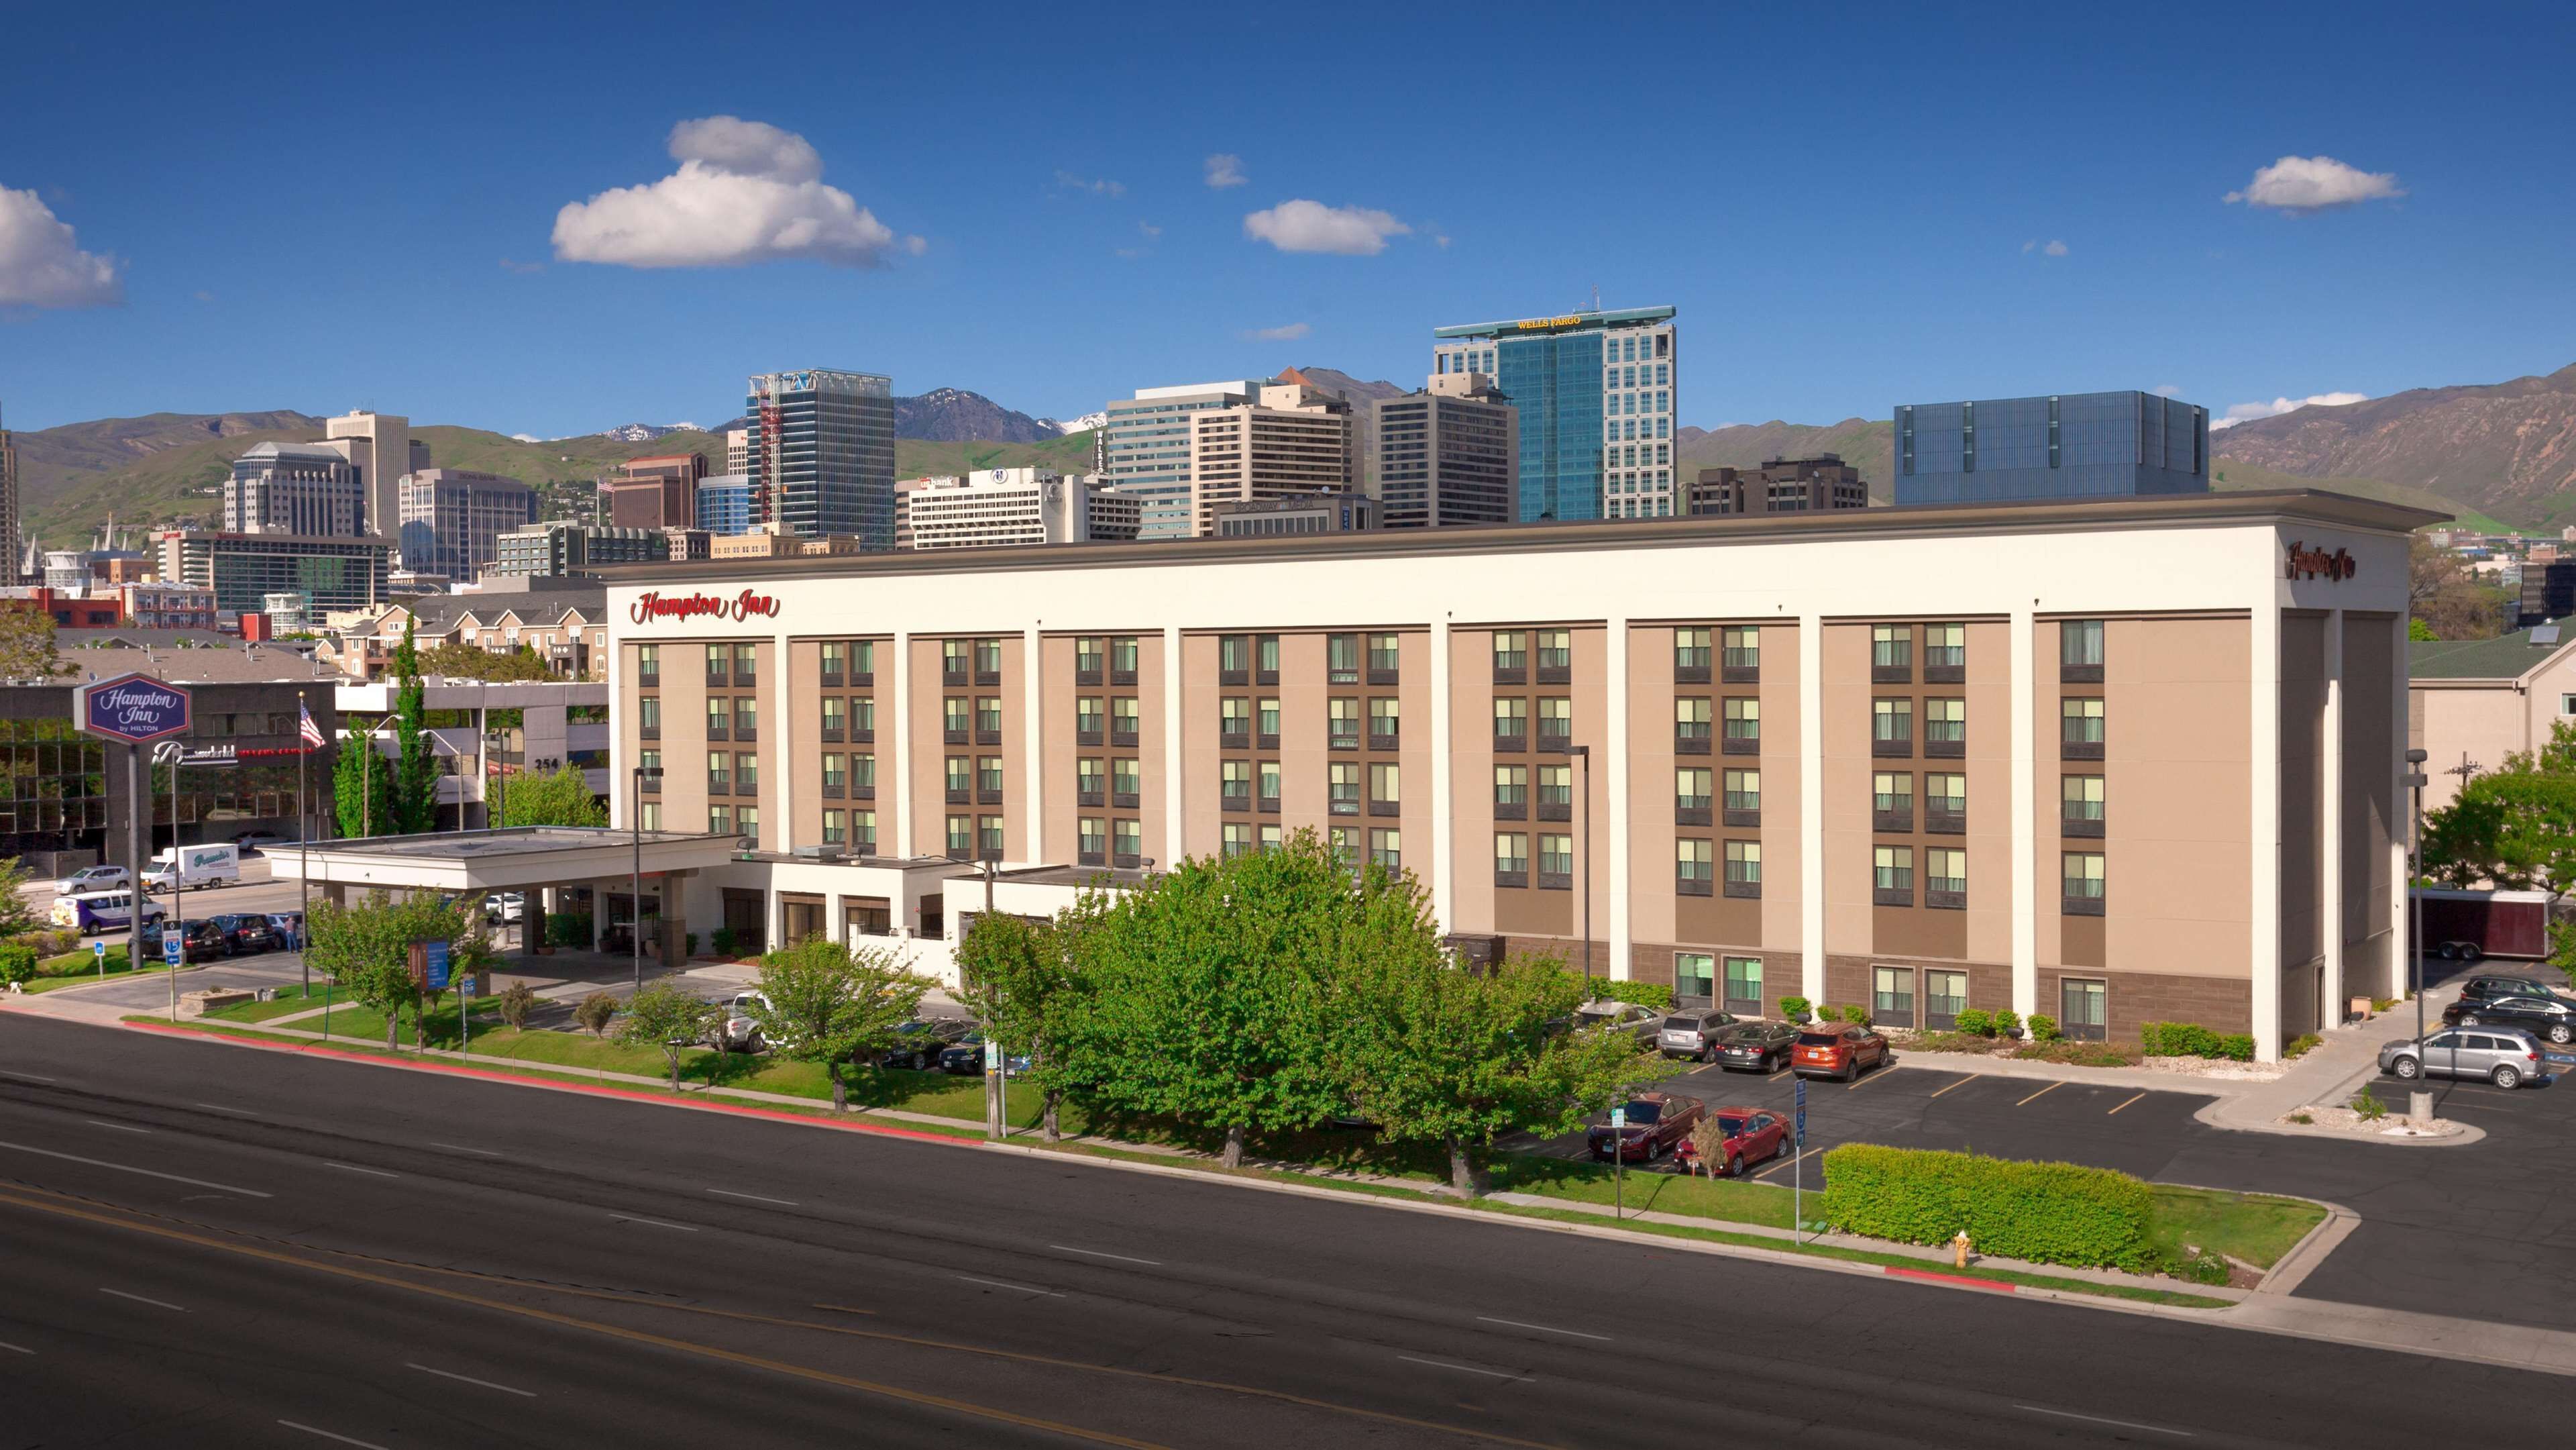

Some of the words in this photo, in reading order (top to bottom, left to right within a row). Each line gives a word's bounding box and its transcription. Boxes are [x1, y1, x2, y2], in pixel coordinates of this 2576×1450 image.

[1518, 319, 1548, 329] WELLS
[1551, 317, 1580, 327] FARGO
[1234, 501, 1278, 513] BROADWAY
[1288, 499, 1315, 511] MEDIA
[630, 590, 729, 625] Hampton
[731, 588, 781, 623] Inn
[101, 688, 177, 711] Hampton
[118, 706, 160, 725] Inn
[535, 758, 558, 770] 254
[168, 941, 178, 951] 15
